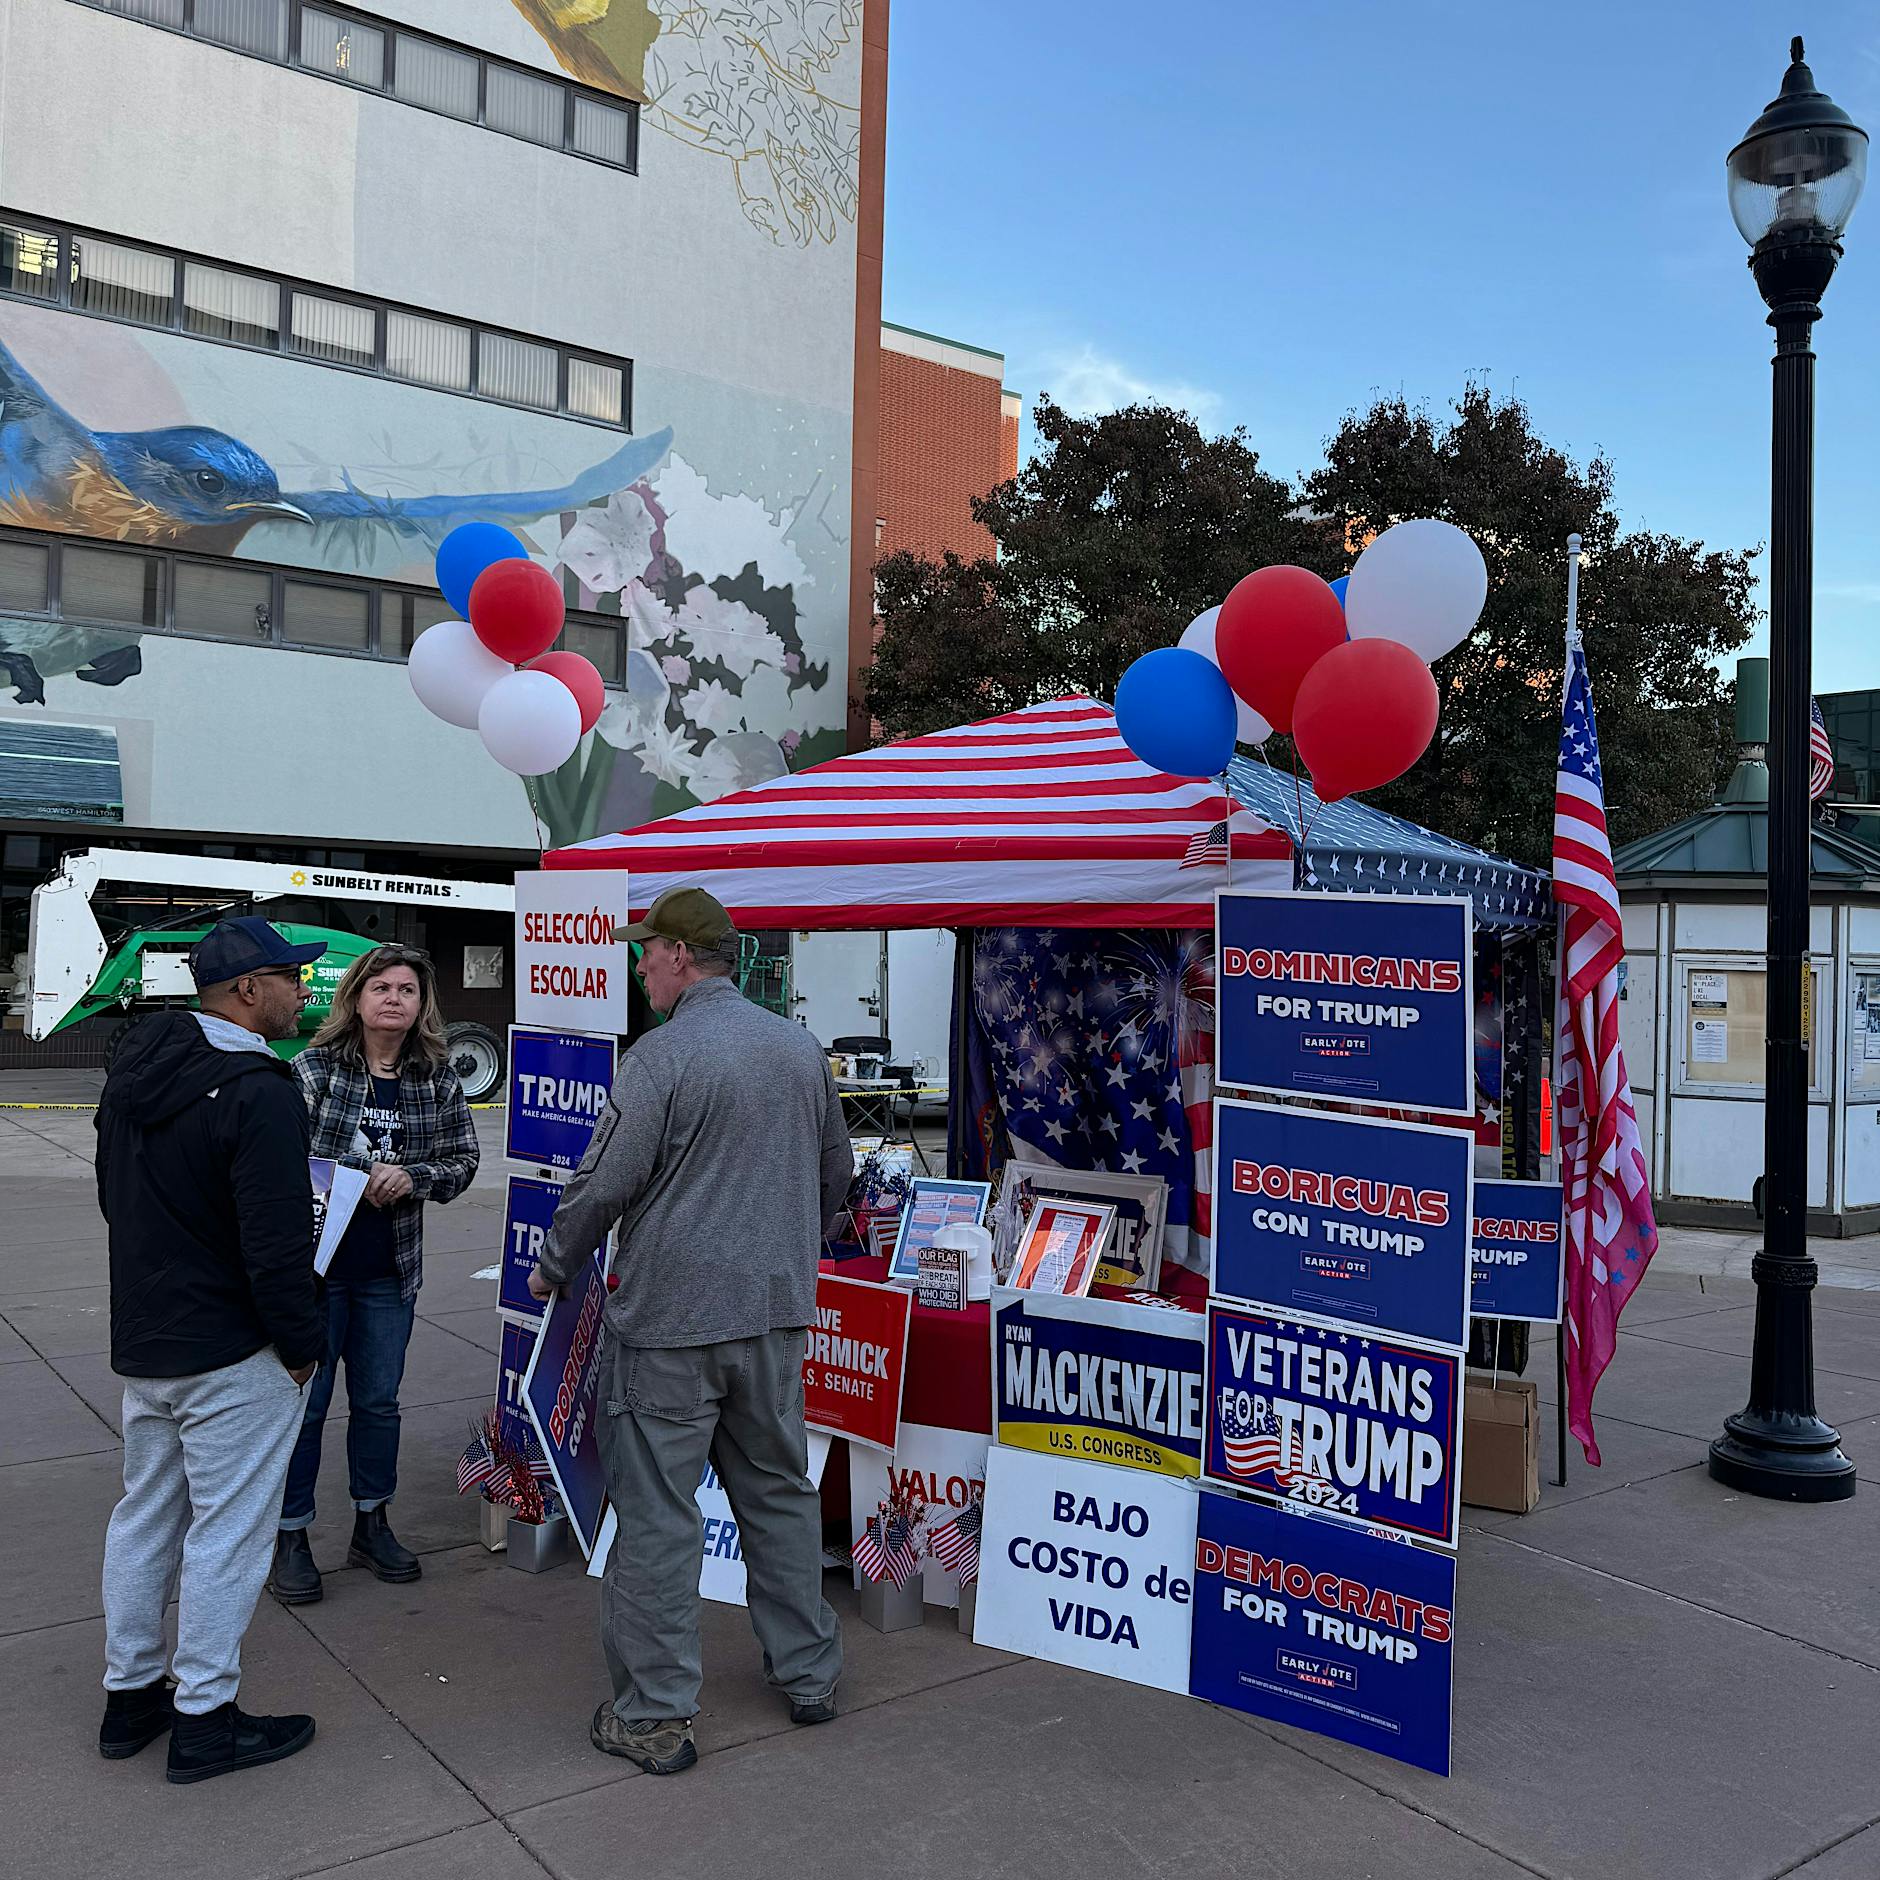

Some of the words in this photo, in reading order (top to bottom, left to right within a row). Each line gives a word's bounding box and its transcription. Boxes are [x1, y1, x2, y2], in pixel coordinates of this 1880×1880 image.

[51, 807, 73, 815] WEST
[75, 809, 116, 817] HAMILTON
[312, 874, 382, 891] SUNBELT
[385, 880, 452, 897] RENTALS
[524, 905, 615, 945] SELECCIÓN
[530, 964, 607, 999] ESCOLAR
[1224, 947, 1461, 993] DOMINICANS
[1257, 995, 1311, 1020] FOR
[1317, 1000, 1420, 1029] TRUMP
[1304, 1038, 1337, 1048] EARLY
[518, 1073, 608, 1116] TRUMP
[522, 1108, 540, 1118] MAKE
[541, 1112, 567, 1123] AMERICA
[567, 1116, 584, 1126] GREAT
[584, 1119, 595, 1128] AGA
[551, 1153, 571, 1166] 2024
[1233, 1159, 1449, 1227] BORICUAS
[1252, 1209, 1309, 1237] CON
[1322, 1219, 1425, 1257] TRUMP
[1472, 1216, 1559, 1242] ICANS
[514, 1257, 530, 1268] MAKE
[918, 1250, 936, 1261] OUR
[938, 1252, 958, 1263] FLAG
[1304, 1257, 1338, 1269] EARLY
[1471, 1248, 1528, 1266] RUMP
[929, 1271, 958, 1283] BREATH
[1320, 1270, 1351, 1279] ACTION
[1472, 1272, 1488, 1280] OTE
[919, 1288, 938, 1299] WHO
[940, 1290, 958, 1301] DIED
[919, 1298, 952, 1308] PROTECTING
[802, 1306, 842, 1332] AVE
[1005, 1324, 1031, 1343] RYAN
[550, 1271, 601, 1450] BORICUAS
[803, 1330, 889, 1380] ORMICK
[802, 1368, 819, 1387] .S.
[825, 1372, 873, 1401] SENATE
[1005, 1343, 1201, 1440] MACKENZIE
[1227, 1327, 1433, 1423] VETERANS
[569, 1401, 587, 1457] CON
[1050, 1430, 1077, 1451] U.S.
[1082, 1435, 1162, 1466] CONGRESS
[1221, 1387, 1268, 1432] FOR
[1273, 1397, 1443, 1505] TRUMP
[1287, 1478, 1360, 1515] 2024
[1053, 1490, 1150, 1538] BAJO
[1008, 1536, 1130, 1589] COSTO
[1144, 1564, 1192, 1604] de
[1196, 1538, 1452, 1643] DEMOCRATS
[1048, 1597, 1141, 1650] VIDA
[1223, 1586, 1288, 1628] FOR
[1302, 1609, 1418, 1665] TRUMP
[1281, 1655, 1320, 1673] EARLY
[1299, 1673, 1335, 1687] ACTION
